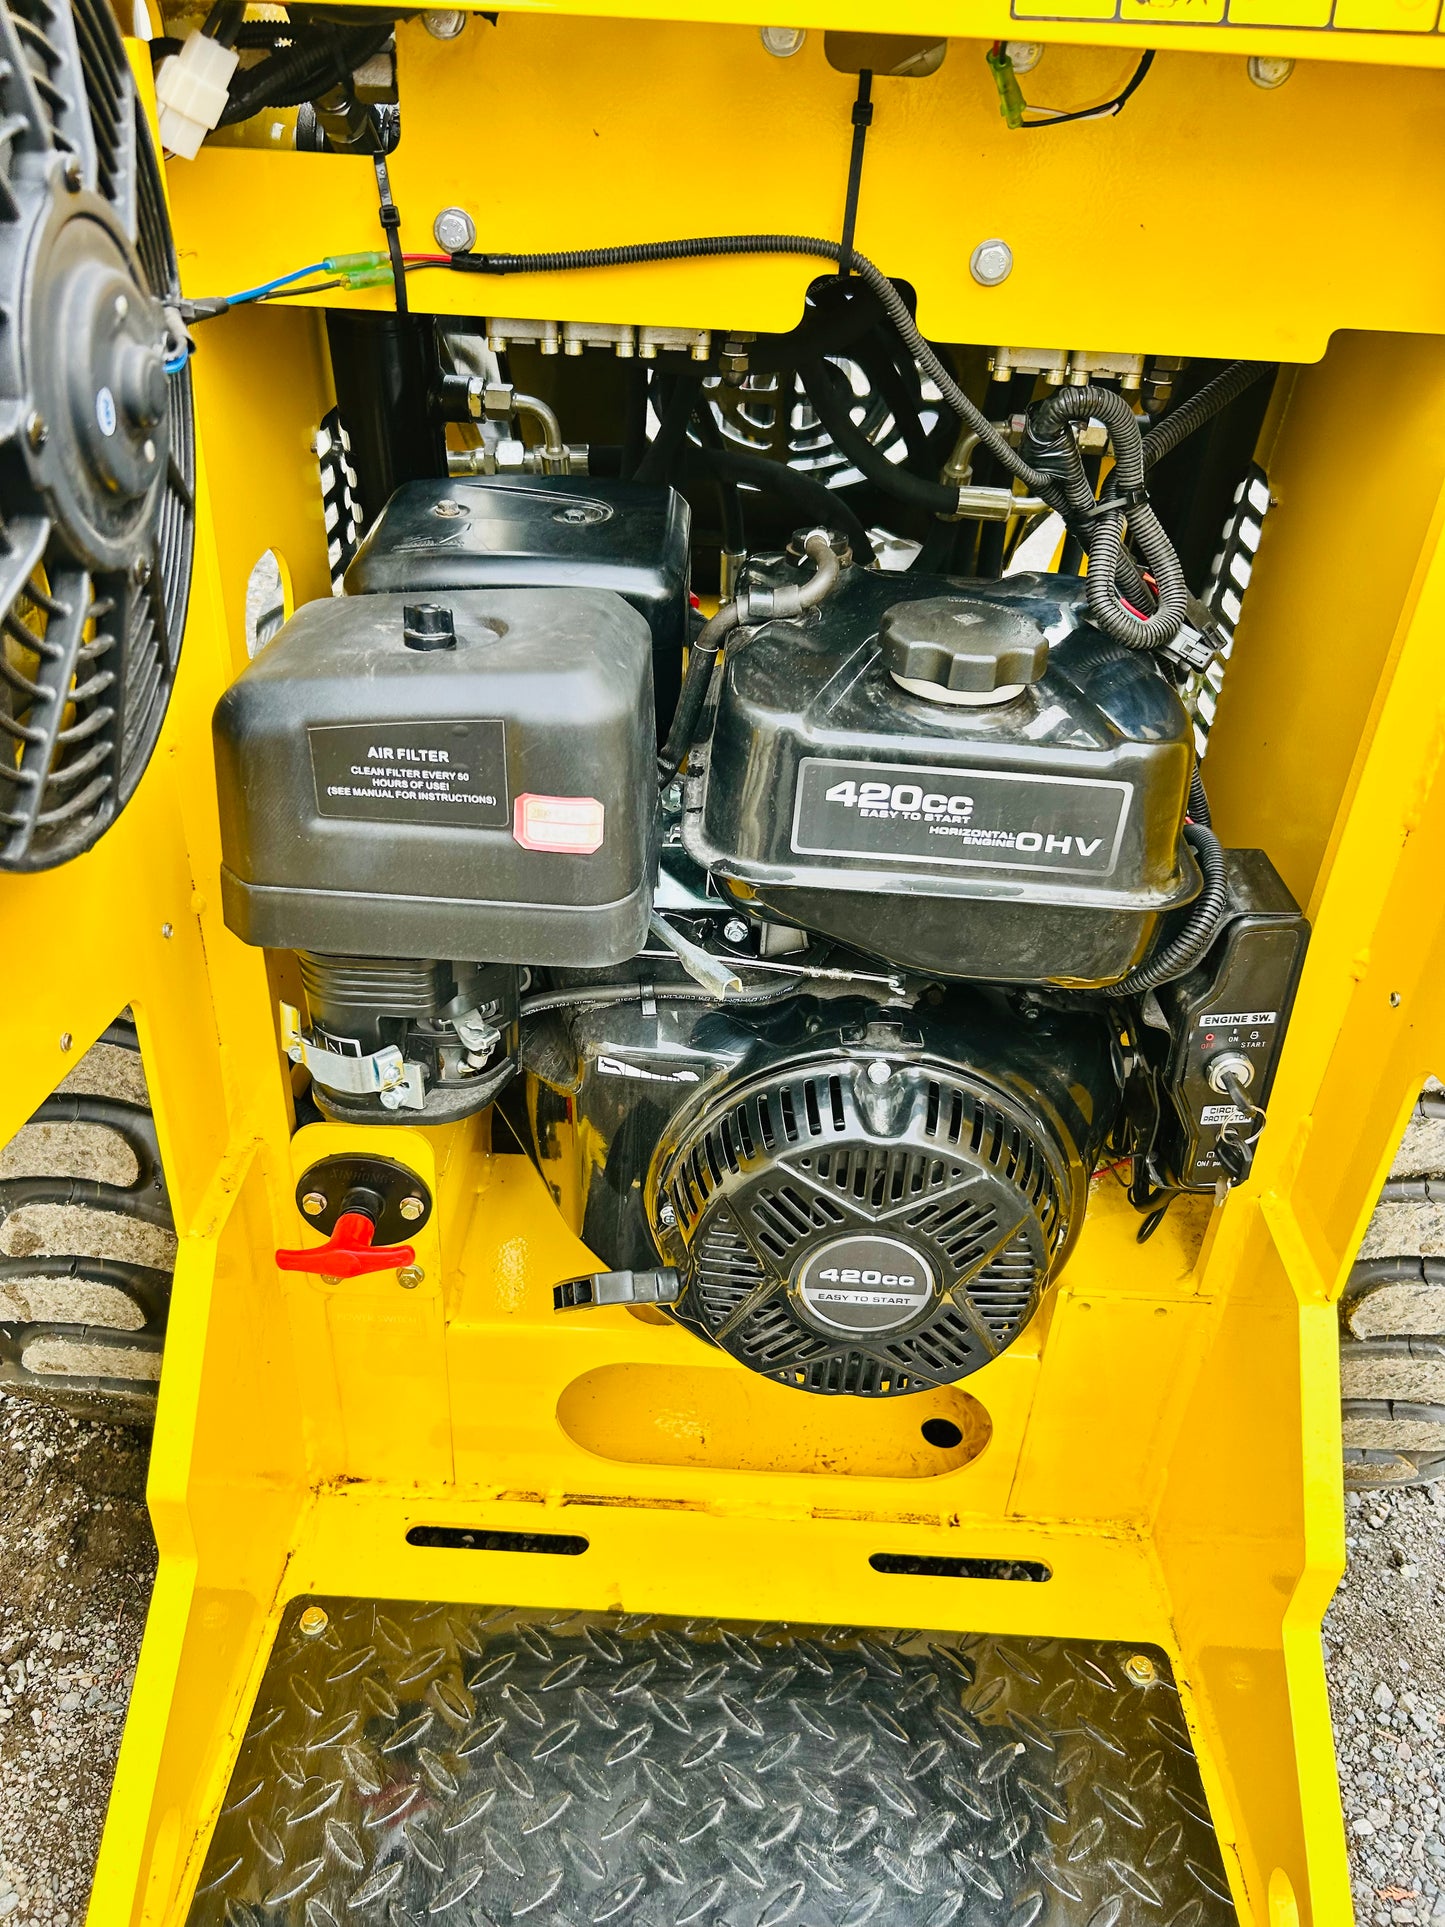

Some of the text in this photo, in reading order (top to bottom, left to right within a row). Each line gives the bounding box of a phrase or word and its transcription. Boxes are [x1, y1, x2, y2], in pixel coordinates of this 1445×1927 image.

[367, 746, 450, 763] AIR FILTER
[350, 766, 470, 782] CLEAN FILTER EVERY 50
[372, 778, 450, 791] HOURS OF USE!
[327, 786, 497, 806] (SEE MANUAL FOR INSTRUCTIONS)
[825, 780, 974, 816] 420cc
[860, 808, 971, 824] EASY TO START
[929, 826, 1103, 857] HORIZONTAL OHV
[962, 837, 1016, 848] ENGINE
[1204, 1014, 1271, 1025] ENGINE SW.
[1240, 1041, 1266, 1049] START
[819, 1268, 916, 1287] 420cc
[818, 1293, 849, 1301] EASY
